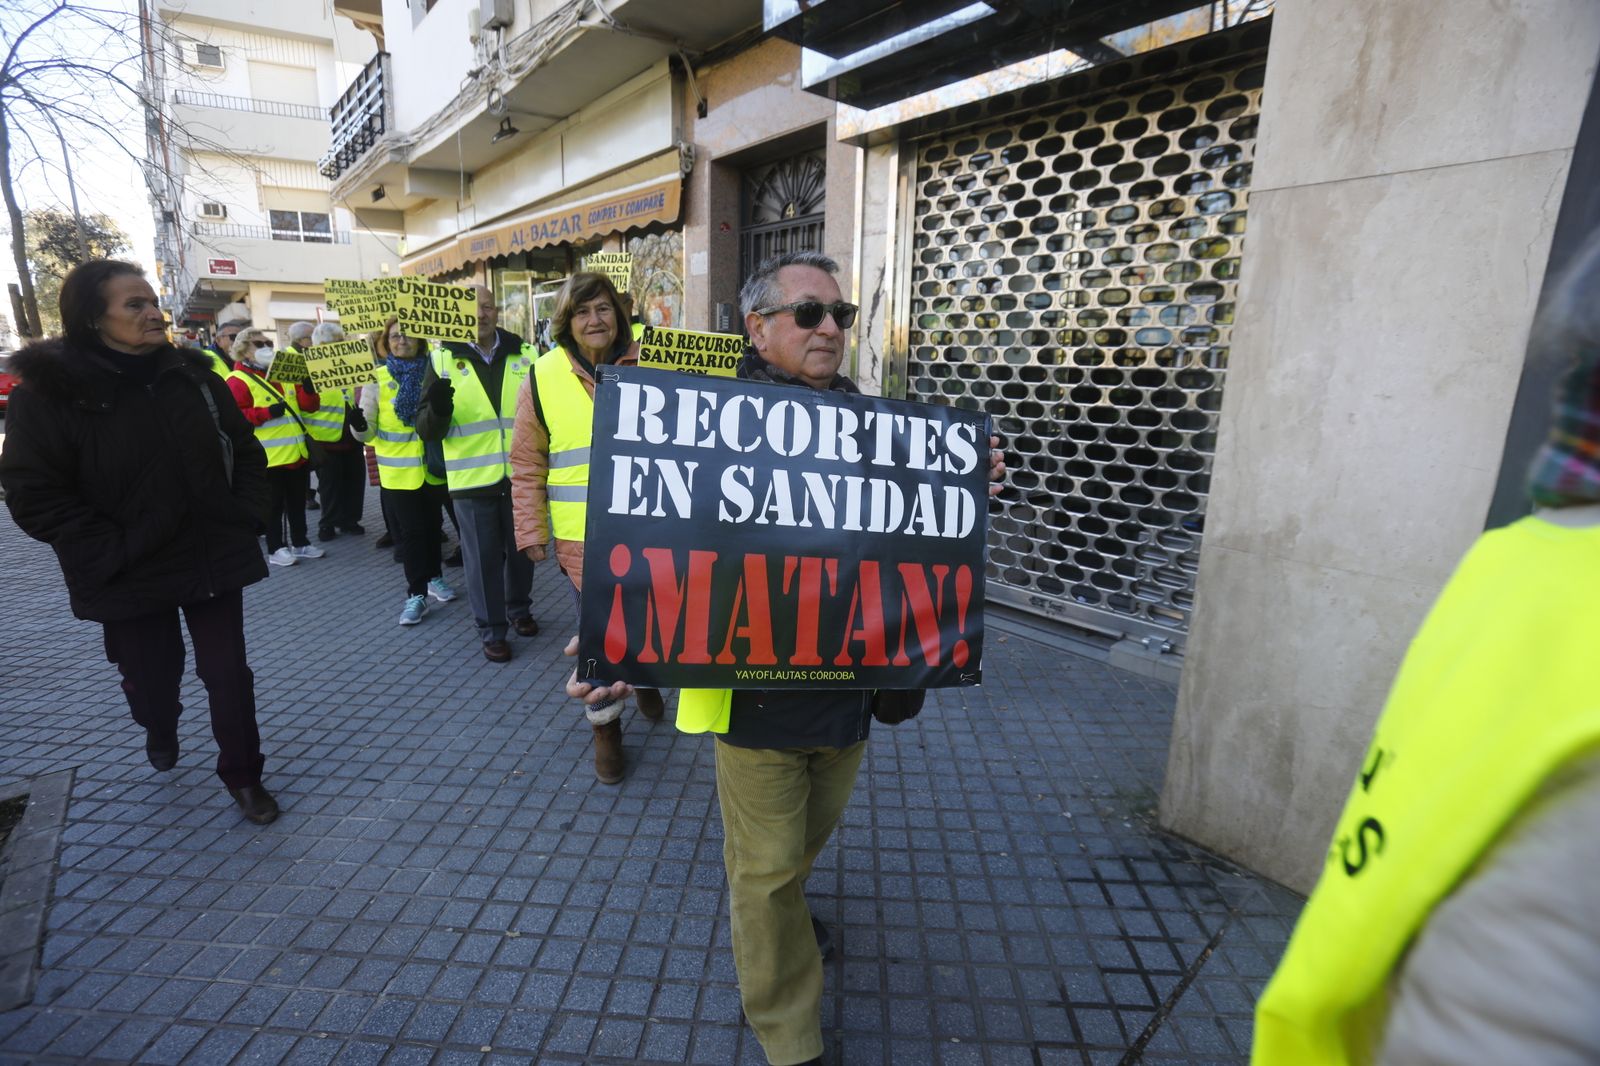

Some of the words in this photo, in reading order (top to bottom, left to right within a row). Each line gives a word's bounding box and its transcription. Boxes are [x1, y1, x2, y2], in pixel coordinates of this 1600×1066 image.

[588, 205, 617, 225] COMPRE
[618, 204, 625, 217] Y
[625, 192, 665, 216] COMPARE
[786, 202, 795, 218] 4
[588, 254, 631, 263] SANIDAD
[331, 280, 366, 289] FUERA
[398, 281, 476, 301] UNIDOS
[336, 299, 361, 307] CUBRIR
[363, 295, 377, 303] TOD
[413, 296, 440, 310] POR
[444, 300, 460, 312] LA
[338, 306, 356, 316] LAS
[398, 307, 476, 327] SANIDAD
[400, 321, 476, 339] PÚBLICA
[642, 328, 674, 348] MAS
[304, 338, 369, 361] RESCATEMOS
[310, 362, 374, 380] SANIDAD
[332, 358, 347, 367] LA
[613, 381, 979, 475] RECORTES
[608, 455, 698, 519] EN
[719, 464, 976, 539] SANIDAD
[604, 543, 973, 669] ¡MATAN!
[735, 670, 807, 680] YAYOFLAUTAS
[809, 669, 855, 680] CÓRDOBA
